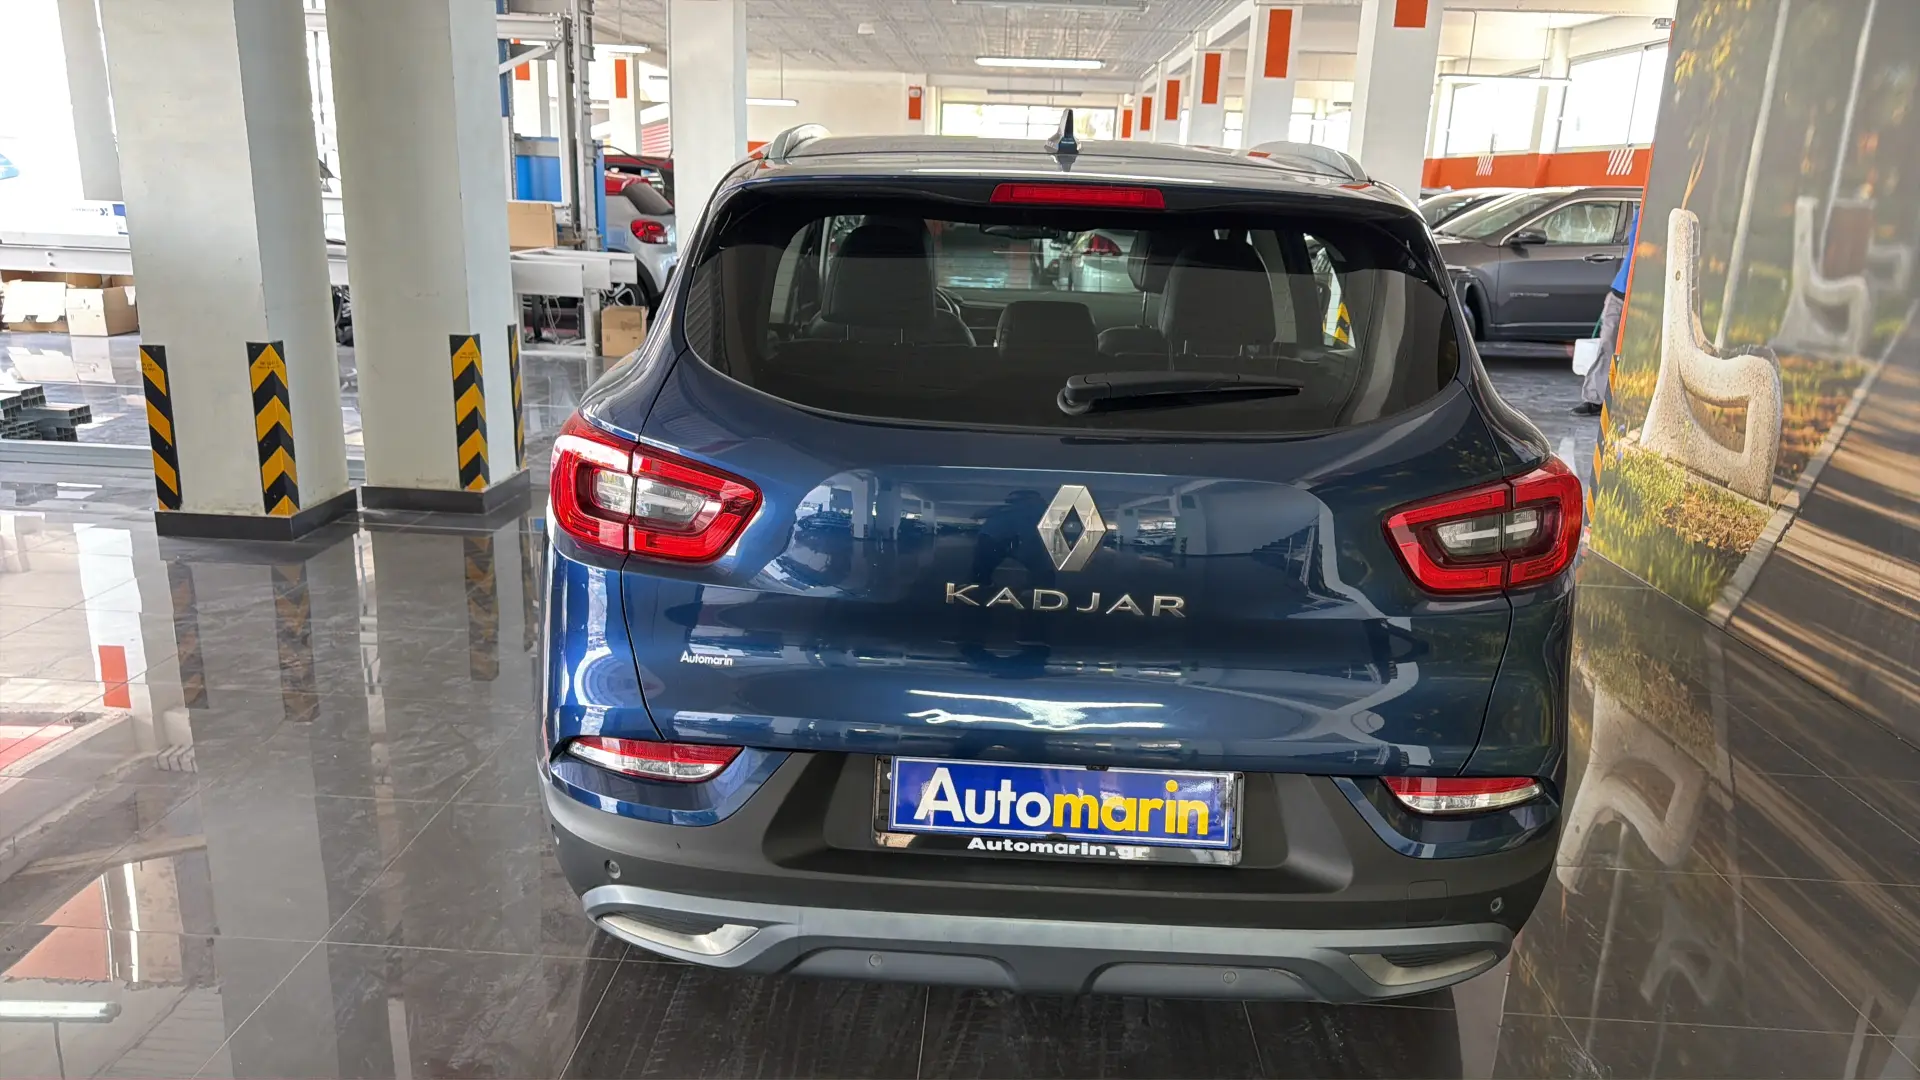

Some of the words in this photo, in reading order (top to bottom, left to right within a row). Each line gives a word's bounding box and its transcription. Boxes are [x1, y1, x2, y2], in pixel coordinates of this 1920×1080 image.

[945, 582, 1186, 618] KADJAR
[680, 650, 733, 666] Automarin
[913, 767, 1209, 835] Automarin
[967, 837, 1150, 859] Automarin.gr
